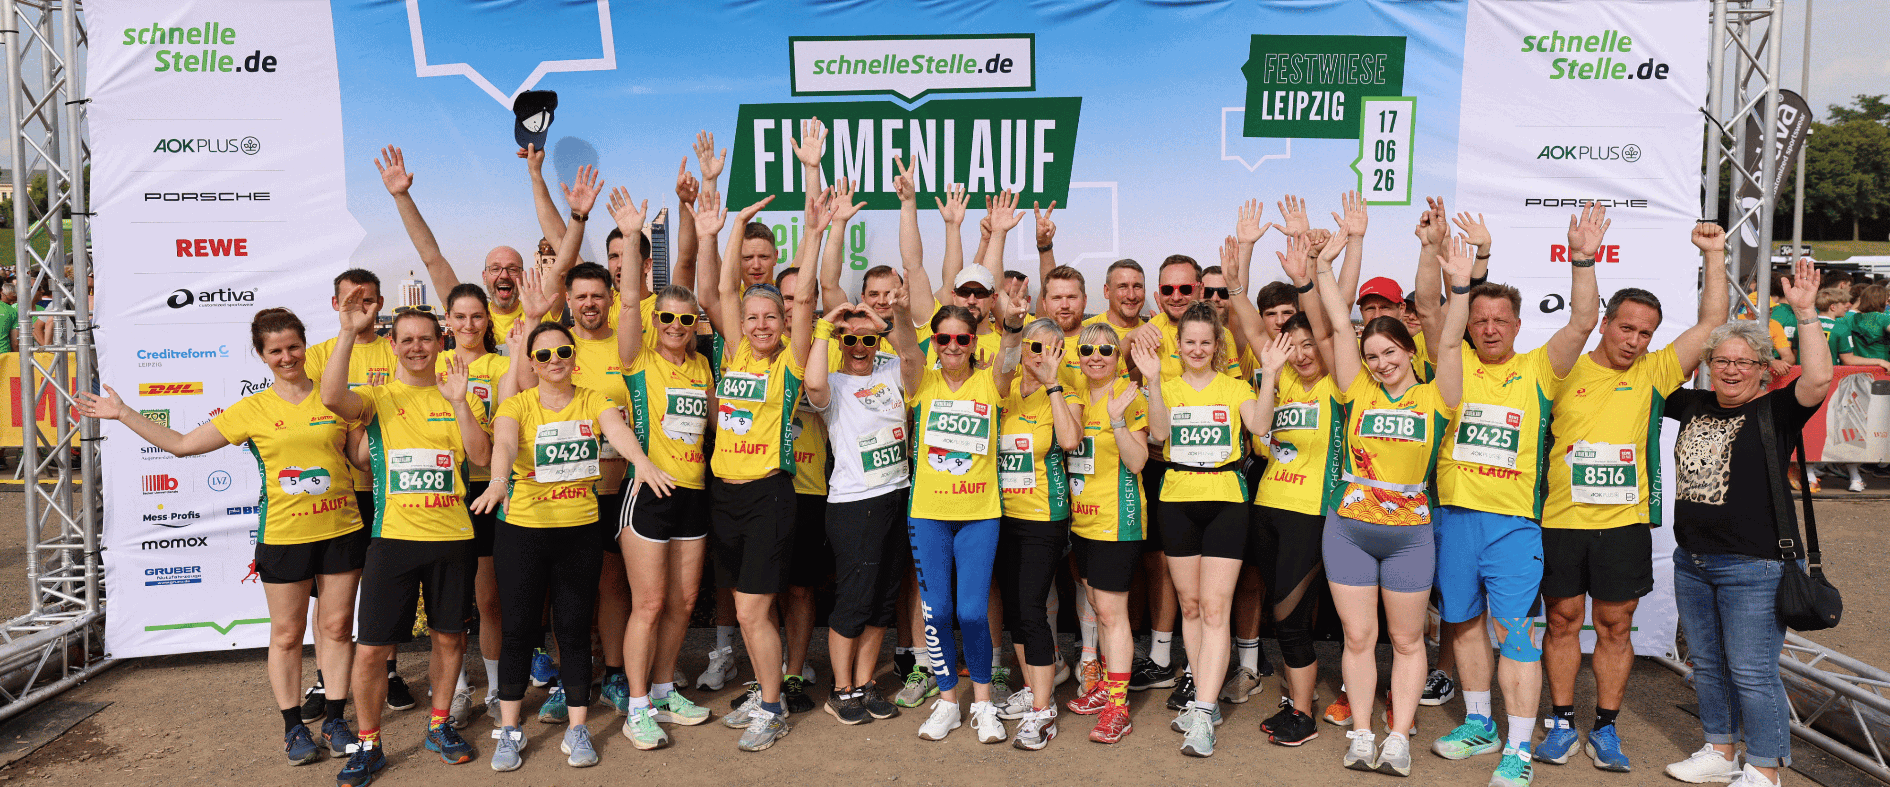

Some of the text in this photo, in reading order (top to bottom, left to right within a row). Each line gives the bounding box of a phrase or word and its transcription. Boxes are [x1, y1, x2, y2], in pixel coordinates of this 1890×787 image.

[122, 22, 236, 45] schnelle
[1521, 30, 1632, 53] schnelle
[154, 50, 278, 73] Stelle.de
[812, 54, 1013, 75] schnelleStelle.de
[1263, 53, 1388, 84] FESTWIESE
[1549, 57, 1669, 80] Stelle.de
[1261, 91, 1345, 121] LEIPZIG
[1378, 110, 1398, 133] 17
[1374, 140, 1396, 162] 06
[1773, 113, 1806, 198] ustomized sportswear
[1372, 168, 1395, 192] 26
[144, 192, 271, 202] PORSCHE
[1525, 198, 1648, 208] PORSCHE
[175, 238, 248, 258] REWE
[137, 348, 217, 359] Creditreform
[148, 384, 195, 395] DHL
[723, 378, 756, 398] 8497
[676, 396, 708, 416] 8503
[937, 414, 981, 435] 8507
[1276, 409, 1306, 427] 8501
[1373, 416, 1415, 436] 8518
[1179, 427, 1222, 444] 8499
[1466, 425, 1512, 448] 9425
[545, 442, 590, 463] 9426
[794, 451, 816, 464] UFT
[872, 446, 901, 468] 8512
[212, 477, 228, 485] LVZ
[399, 471, 445, 490] 8498
[1274, 469, 1307, 486] LÄUFT
[1584, 467, 1626, 484] 8516
[952, 480, 986, 494] LÄUFT
[312, 495, 348, 515] LÄUFT
[141, 537, 208, 550] momox
[144, 565, 201, 576] GRUBER
